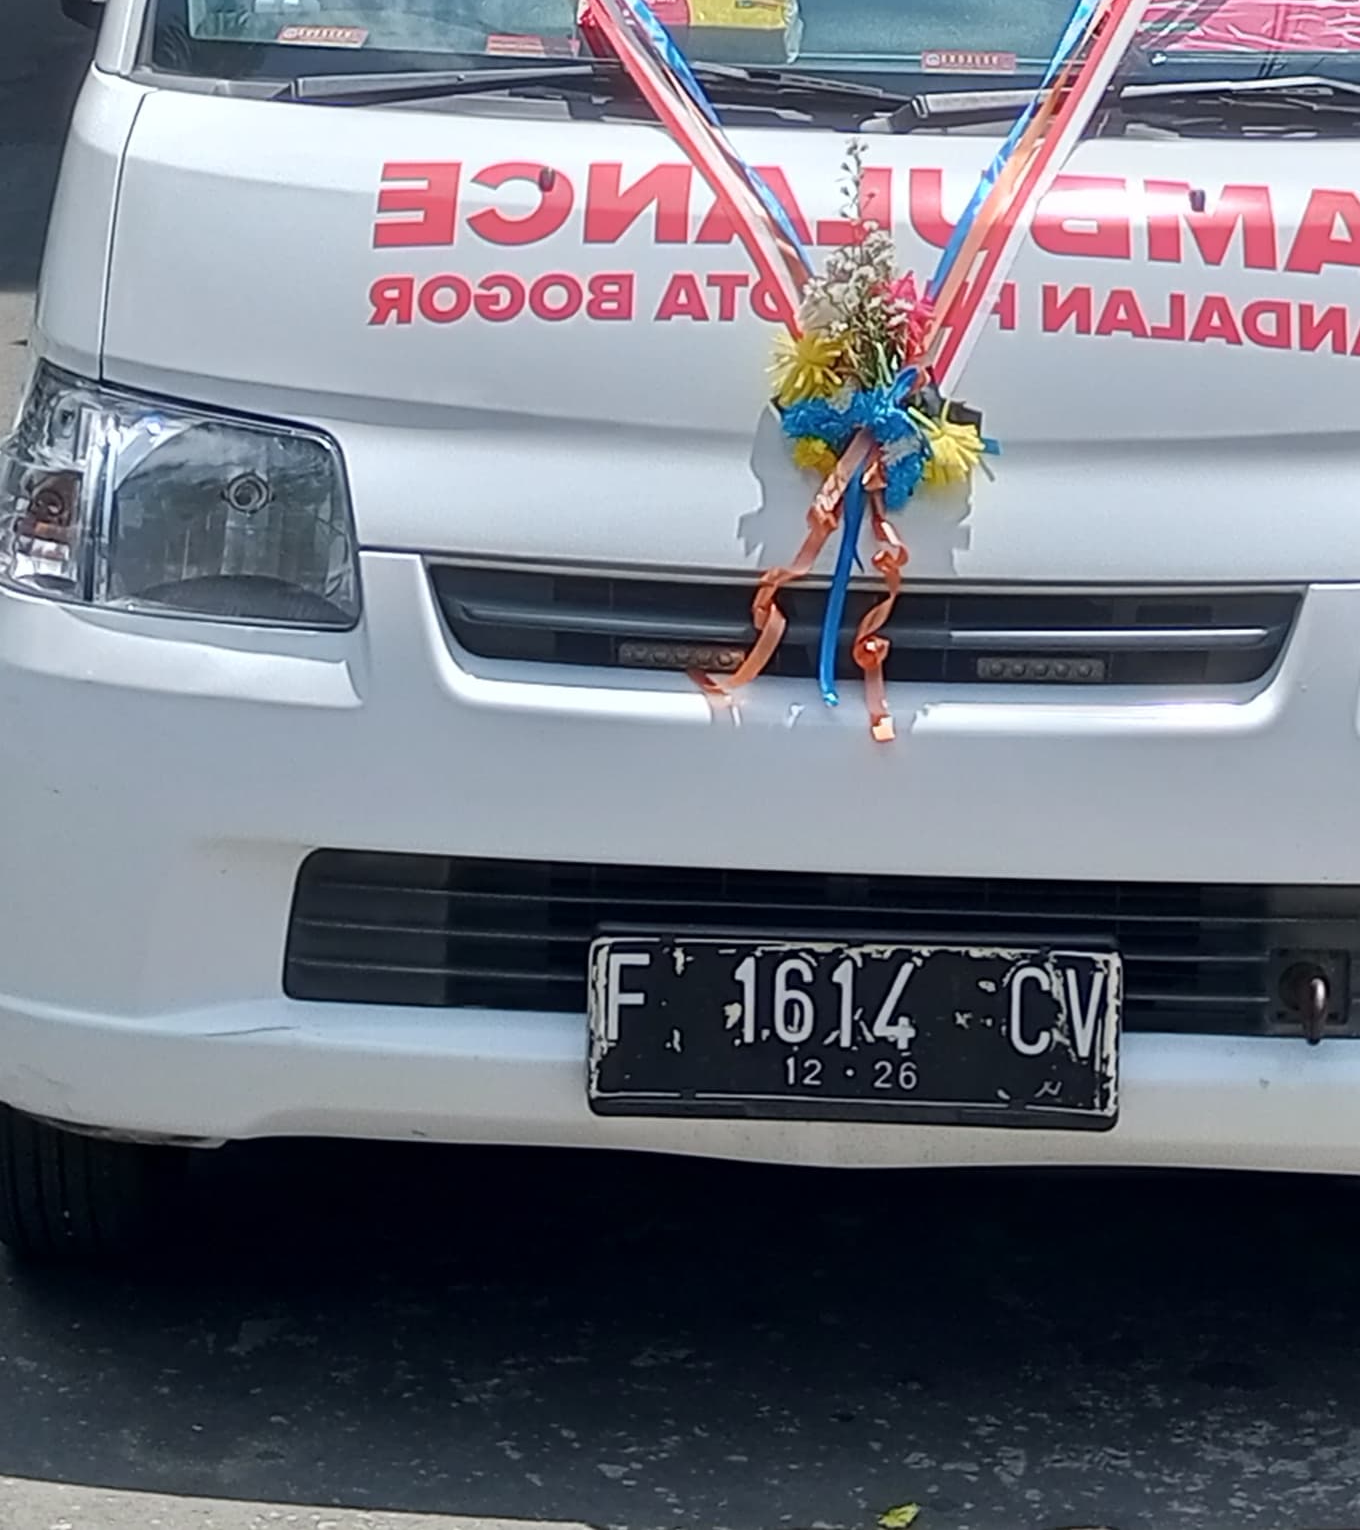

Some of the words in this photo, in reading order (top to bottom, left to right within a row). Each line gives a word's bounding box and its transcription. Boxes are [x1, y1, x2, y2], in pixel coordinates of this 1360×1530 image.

[606, 952, 651, 1042] F
[734, 956, 917, 1051] 1614
[1010, 966, 1105, 1058] CV
